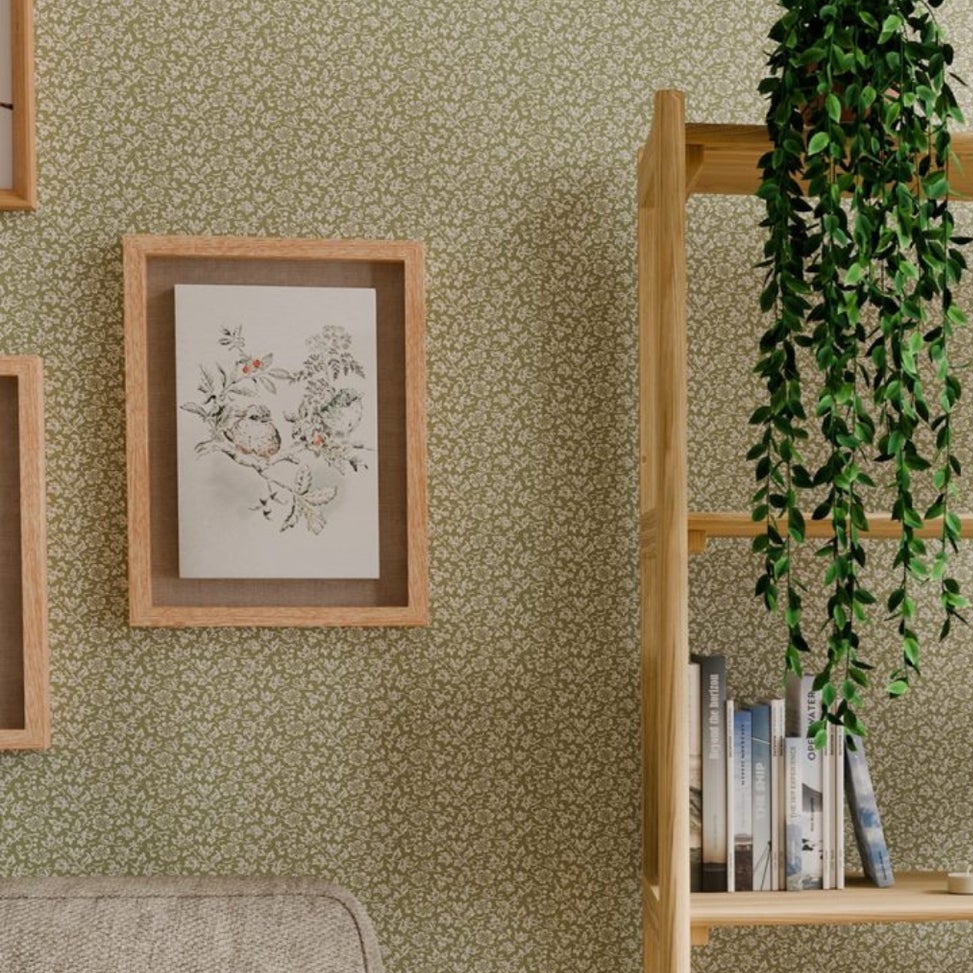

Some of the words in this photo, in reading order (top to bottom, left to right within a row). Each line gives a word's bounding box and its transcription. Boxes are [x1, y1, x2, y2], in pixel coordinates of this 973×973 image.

[709, 674, 719, 708] horizon
[709, 710, 719, 724] the
[709, 727, 721, 759] Beyond
[807, 734, 817, 761] OPE
